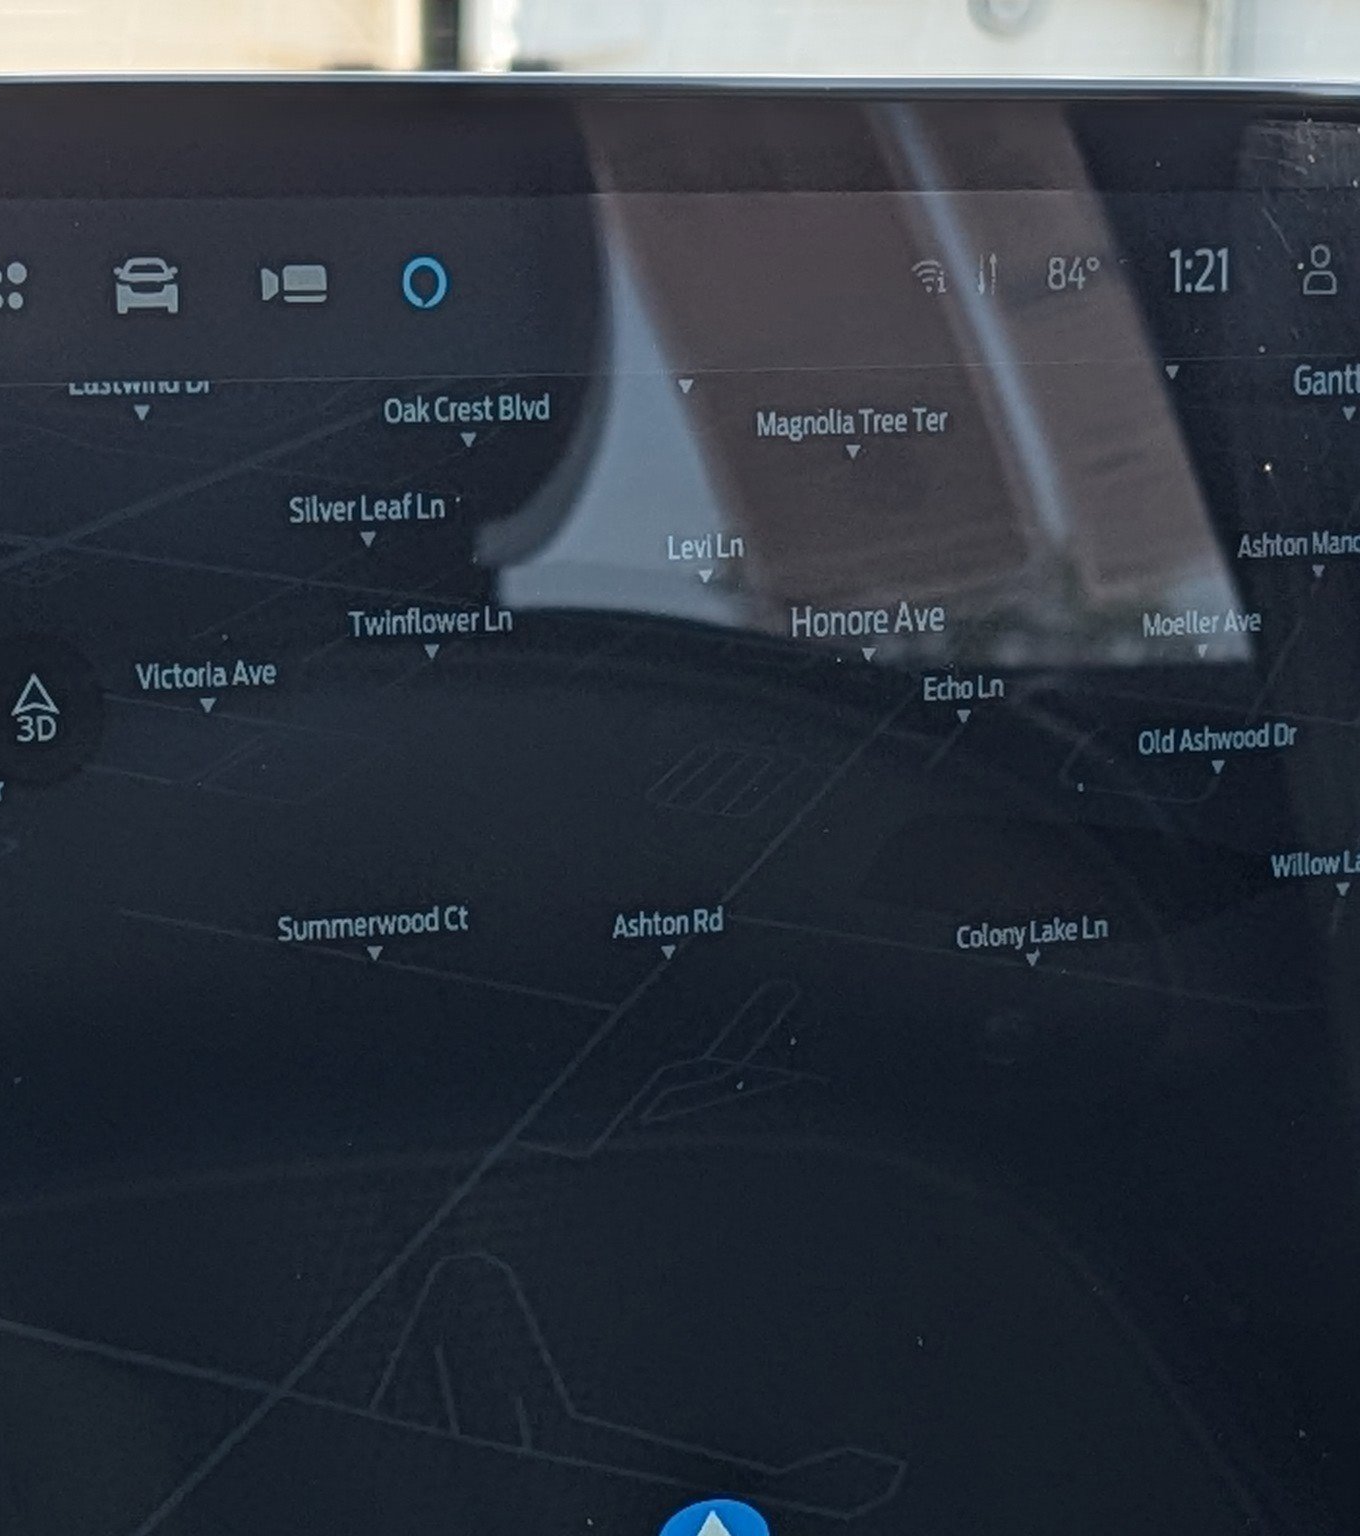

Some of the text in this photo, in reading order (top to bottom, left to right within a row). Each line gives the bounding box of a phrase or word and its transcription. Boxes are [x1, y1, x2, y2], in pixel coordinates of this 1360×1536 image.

[1047, 256, 1100, 290] 84°
[1169, 247, 1229, 294] 1:21
[383, 392, 551, 424] Oak Crest Blvd
[756, 406, 949, 442] Magnolia Tree Ter
[288, 491, 446, 524] Silver Leaf Ln
[667, 532, 745, 560] Levi Ln
[1237, 531, 1309, 559] Ashton
[347, 604, 514, 638] Twinflower Ln
[791, 601, 945, 638] Honore Ave
[1142, 608, 1262, 638] Moeller Ave
[134, 659, 277, 690] Victoria Ave
[923, 674, 1005, 702] Echo Ln
[16, 715, 57, 743] 3D
[1138, 721, 1298, 756] Old Ashwood Dr
[1270, 851, 1342, 879] Willow
[277, 904, 469, 943] Summerwood Ct
[612, 904, 724, 940] Ashton Rd
[956, 914, 1109, 949] Colony Lake Ln
